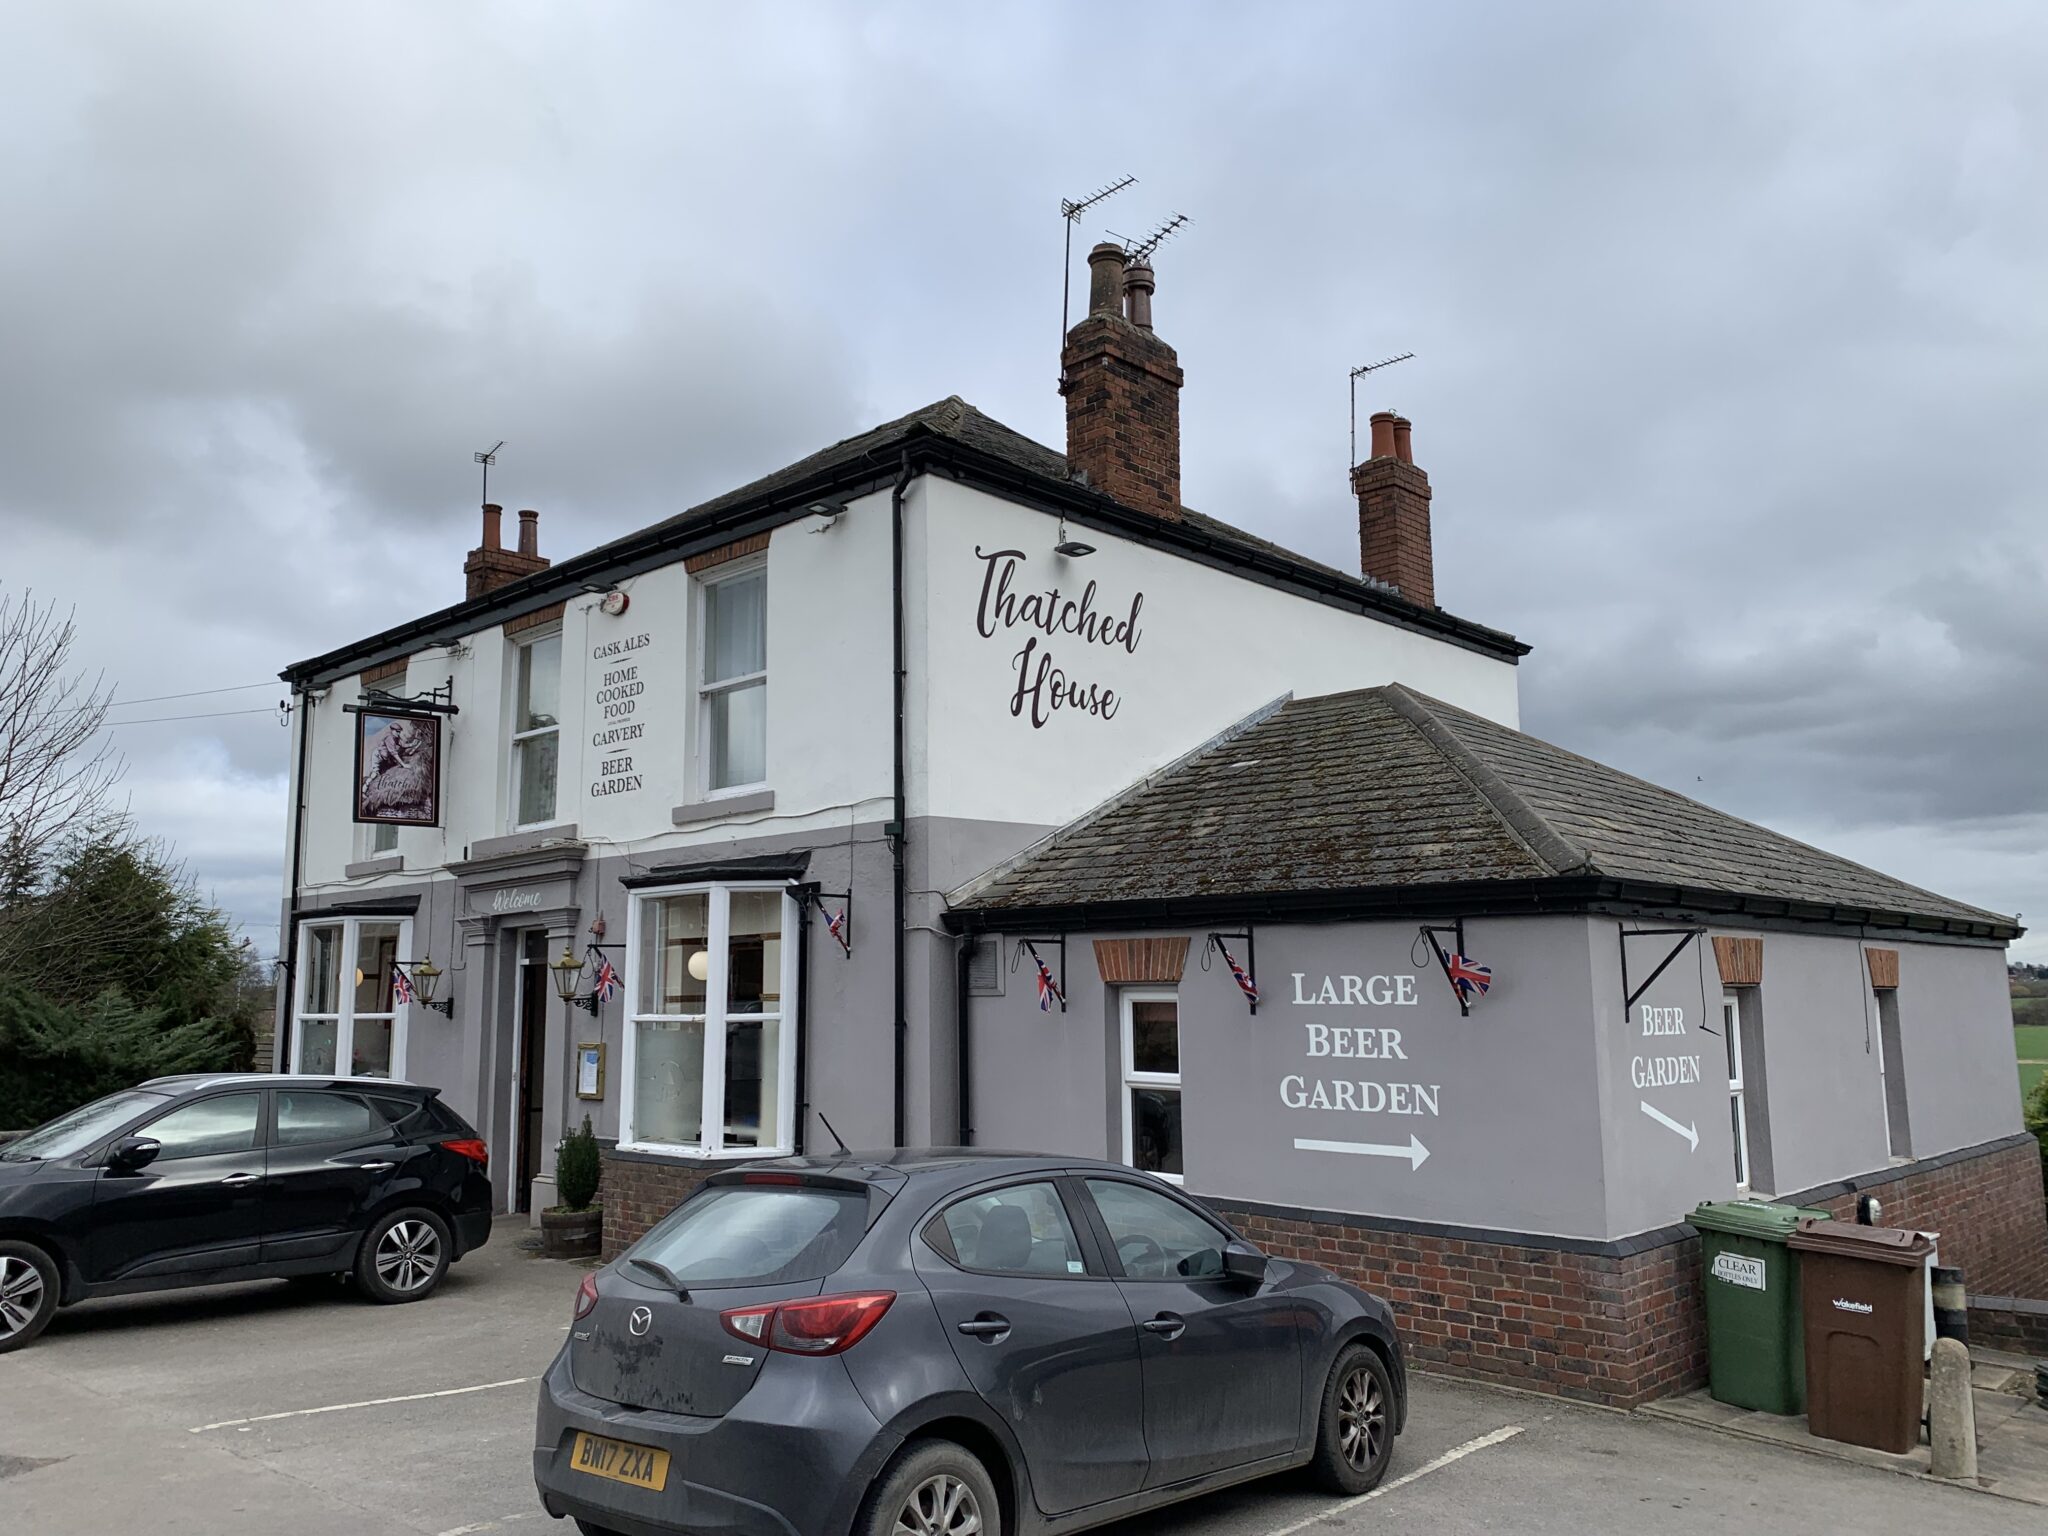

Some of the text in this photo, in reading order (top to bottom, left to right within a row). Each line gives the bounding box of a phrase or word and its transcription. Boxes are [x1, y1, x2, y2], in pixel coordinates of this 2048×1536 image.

[975, 545, 1144, 654] Thatched
[593, 633, 650, 660] CASK ALES
[603, 666, 638, 687] HOME
[1010, 637, 1121, 729] House
[596, 681, 645, 705] COOKED
[603, 700, 636, 719] FOOD
[592, 723, 645, 747] CARVERY
[601, 756, 633, 776] BEER
[591, 774, 643, 798] GARDEN
[492, 888, 541, 911] Welcome
[1291, 973, 1418, 1005] LARGE
[1641, 1004, 1686, 1036] BEER
[1305, 1023, 1408, 1059] BEER
[1631, 1055, 1700, 1088] GARDEN
[1279, 1075, 1440, 1116] GARDEN
[1718, 1258, 1756, 1275] CLEAR
[580, 1438, 654, 1482] BW17 ZXA
